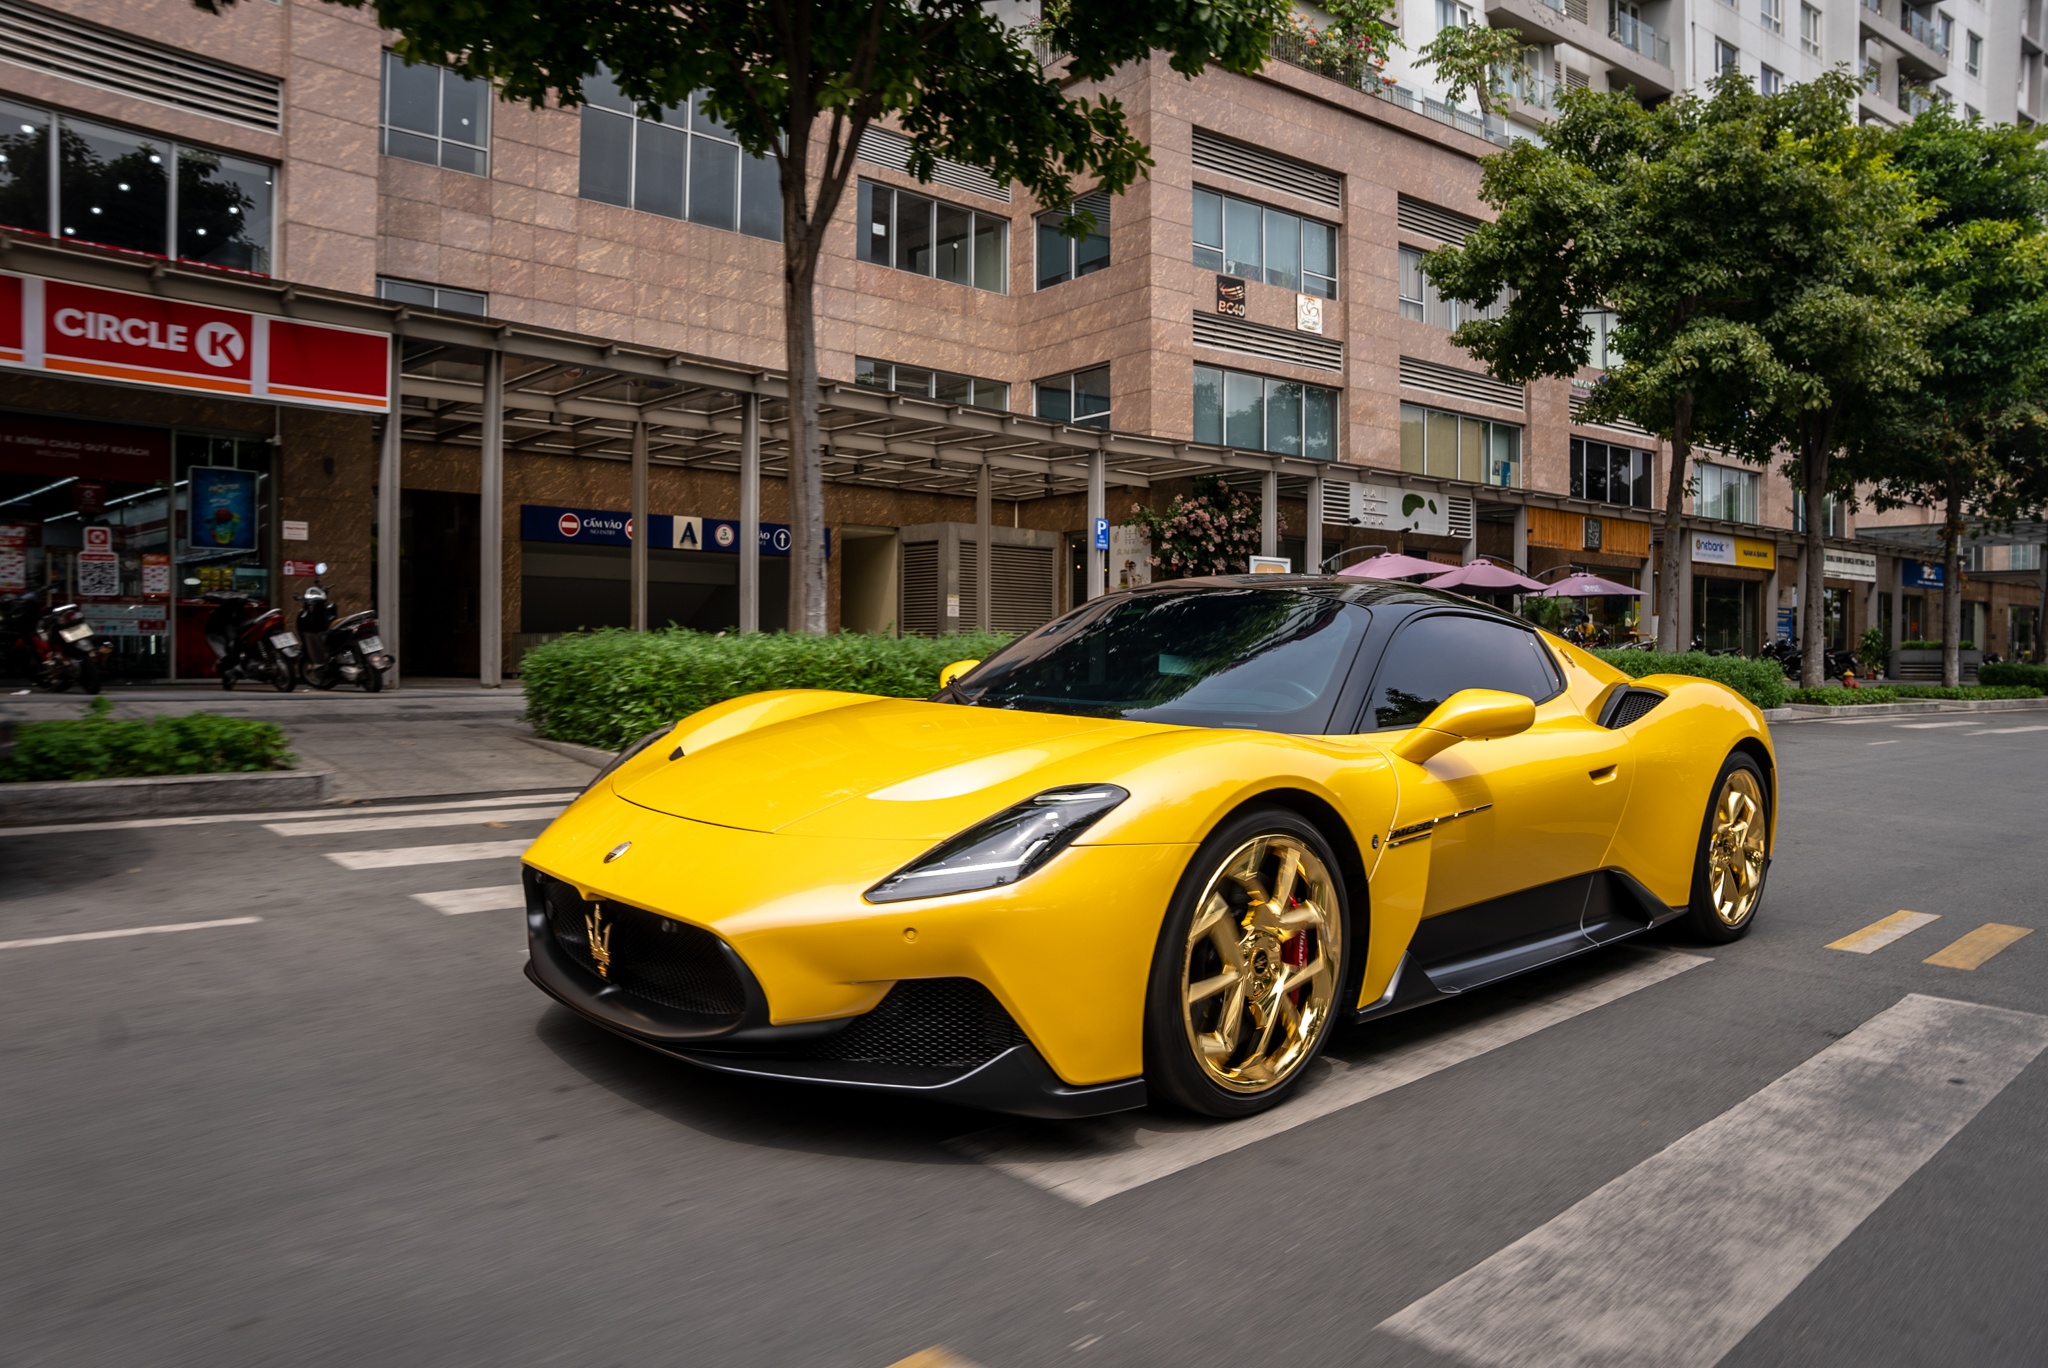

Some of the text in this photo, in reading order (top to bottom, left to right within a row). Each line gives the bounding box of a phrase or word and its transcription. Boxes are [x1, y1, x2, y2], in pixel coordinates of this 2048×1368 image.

[1218, 300, 1245, 317] BC40
[54, 308, 243, 366] CIRCLE K
[604, 518, 623, 530] VÀO
[1097, 520, 1107, 535] P
[680, 521, 698, 544] A
[722, 528, 728, 537] 5
